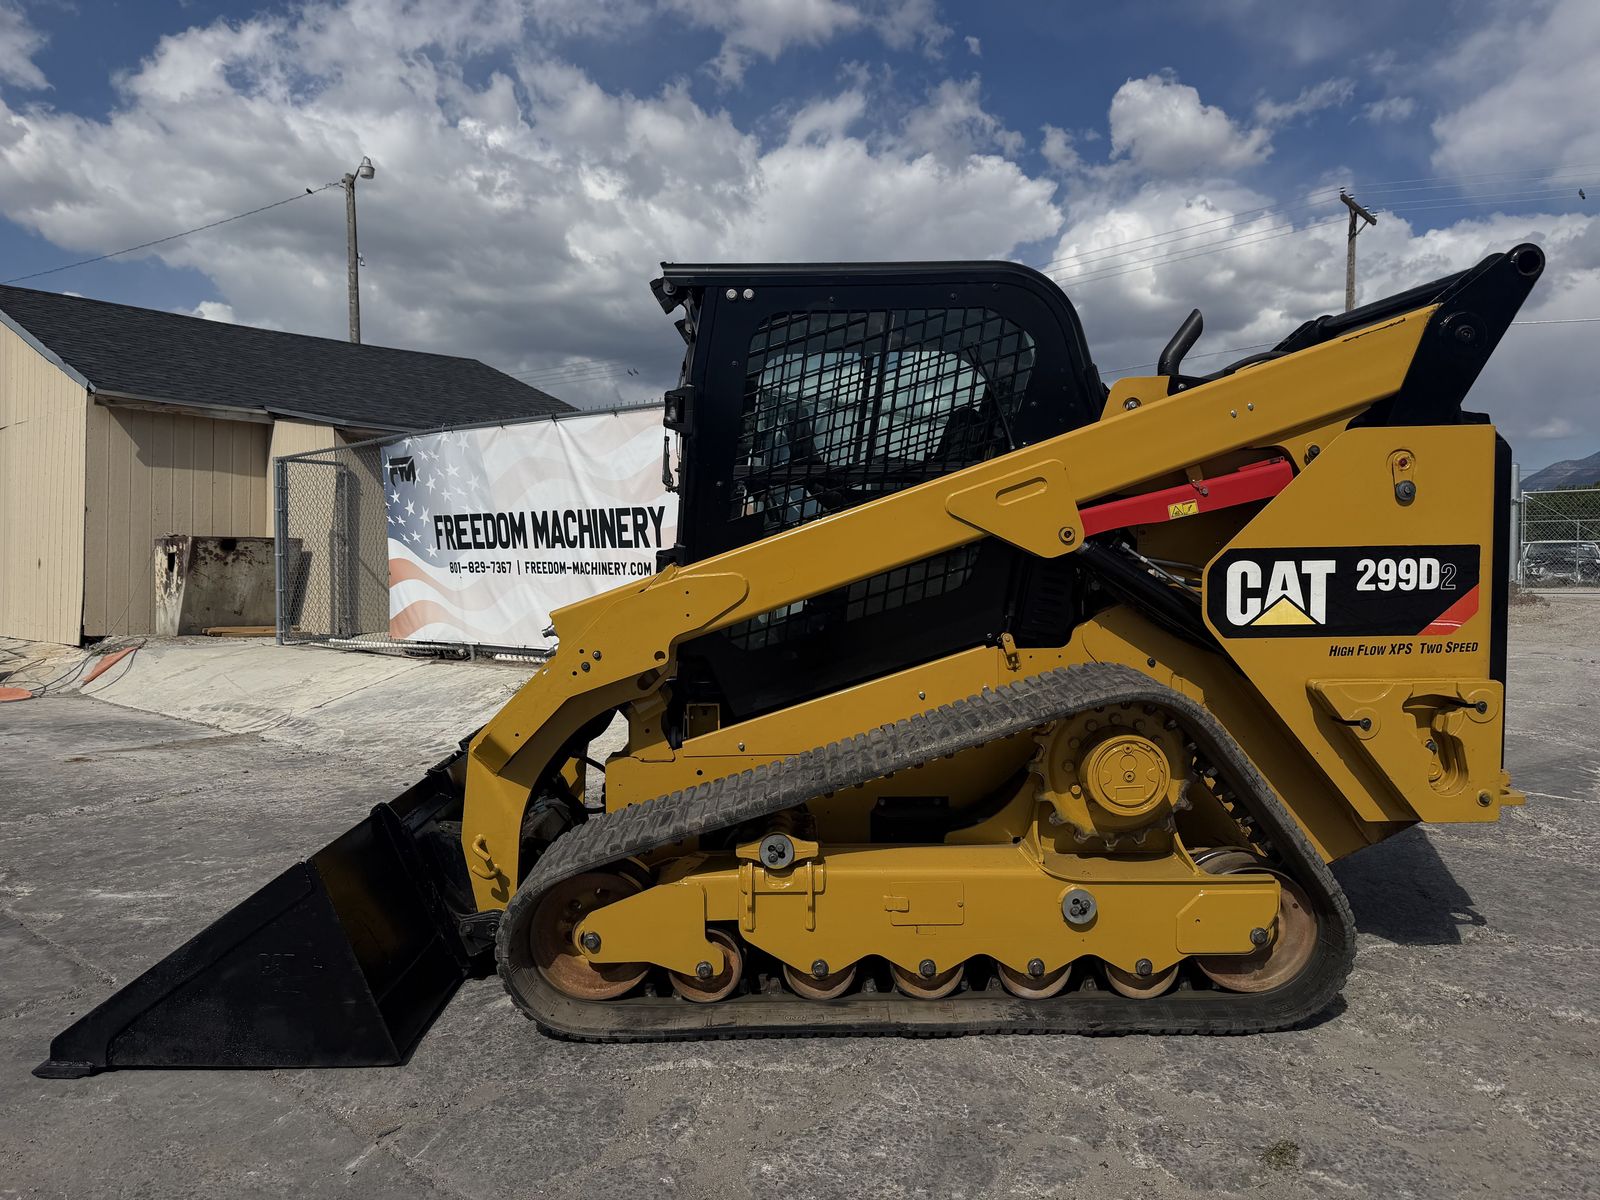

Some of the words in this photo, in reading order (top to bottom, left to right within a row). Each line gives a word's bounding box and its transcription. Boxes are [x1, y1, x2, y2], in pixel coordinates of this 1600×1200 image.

[433, 511, 528, 551] FREEDOM
[530, 505, 666, 549] MACHINERY
[449, 561, 512, 574] 801-829-7367
[525, 560, 652, 576] FREEDOM-MACHINERY.COM
[1226, 559, 1336, 626] CAT
[1388, 642, 1413, 655] XPS
